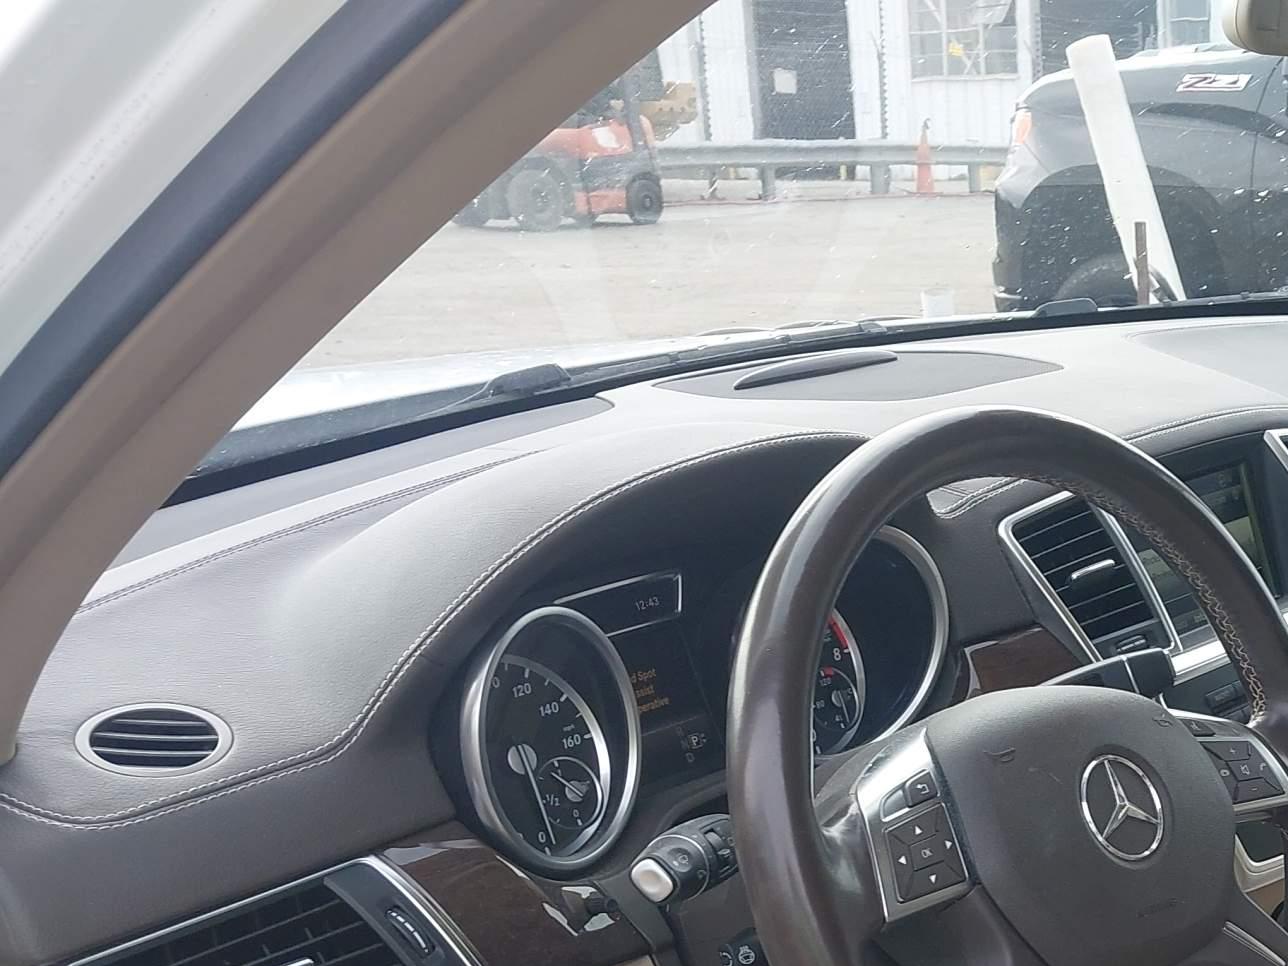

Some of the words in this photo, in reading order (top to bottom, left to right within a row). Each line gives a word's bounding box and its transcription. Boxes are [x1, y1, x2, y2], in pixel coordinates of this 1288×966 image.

[833, 648, 841, 661] 8
[512, 682, 532, 698] 120
[539, 701, 559, 717] 140
[562, 733, 581, 749] 160
[538, 831, 546, 843] 0
